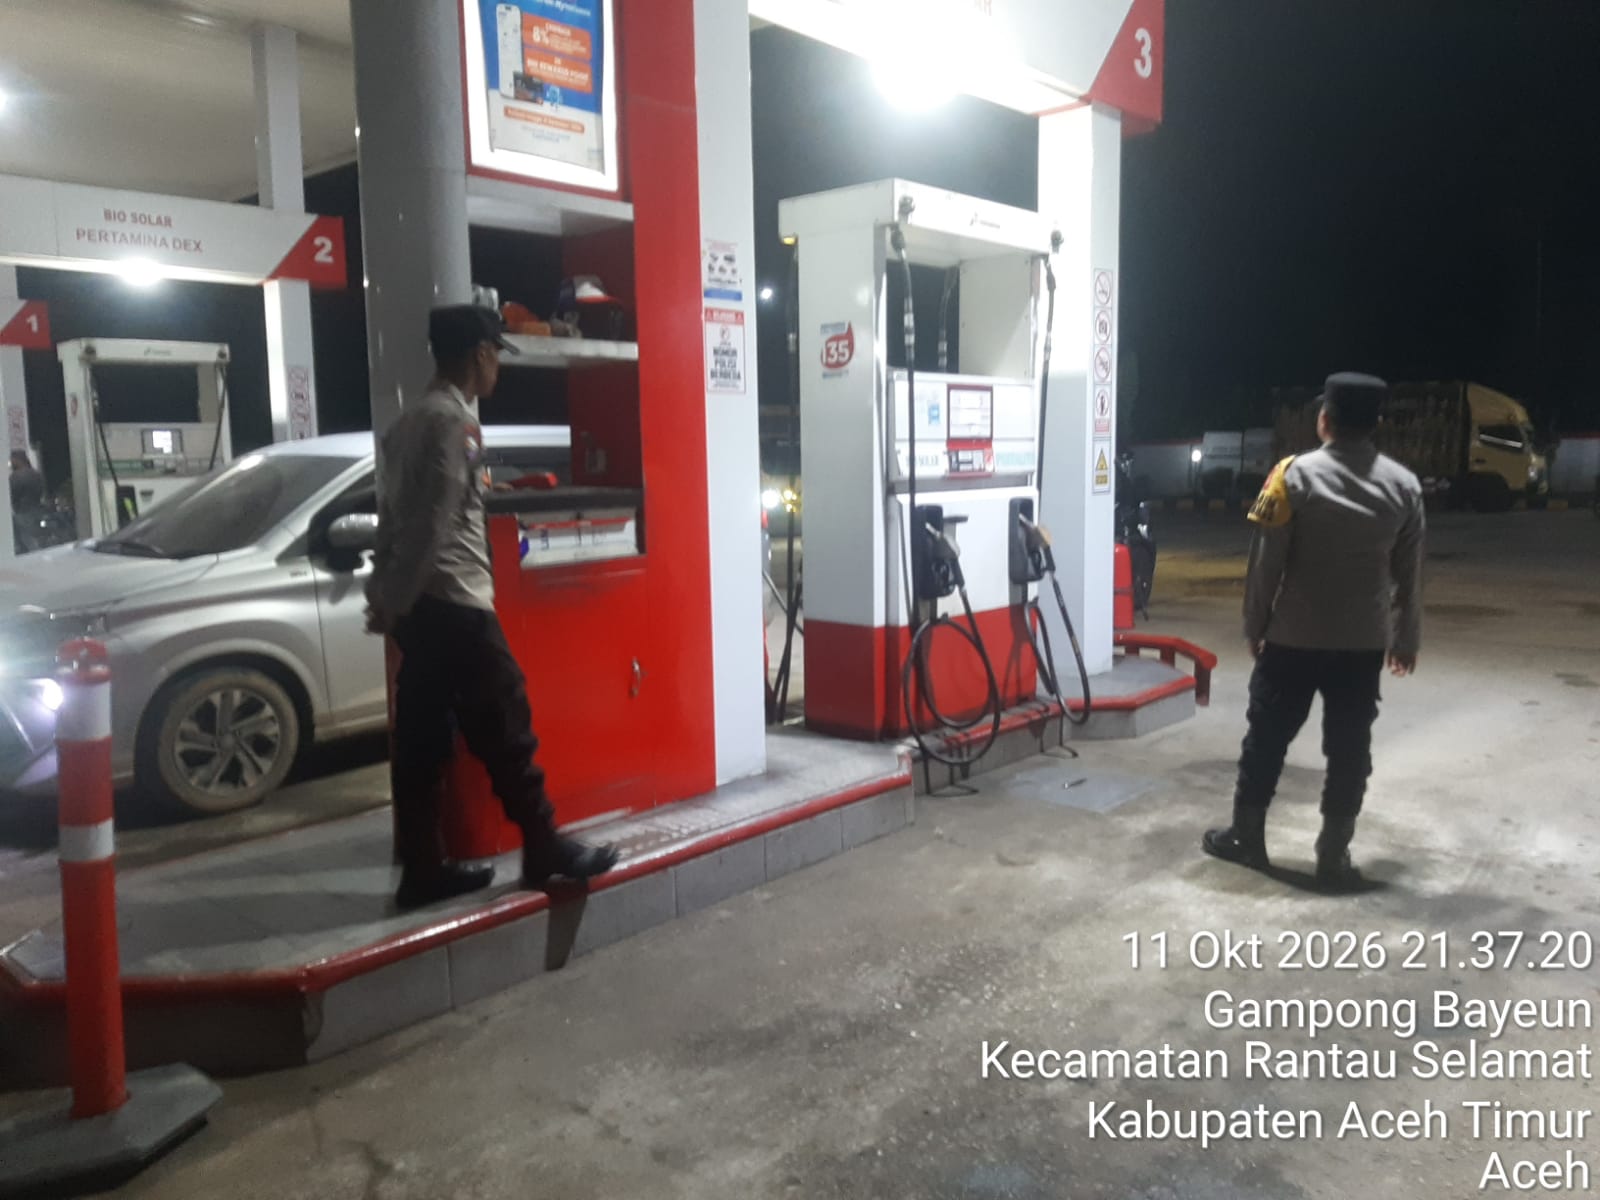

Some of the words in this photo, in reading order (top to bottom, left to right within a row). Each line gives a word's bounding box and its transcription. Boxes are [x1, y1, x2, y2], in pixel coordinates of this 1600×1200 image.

[1134, 27, 1152, 78] 3
[103, 208, 127, 224] BIO
[130, 211, 173, 228] SOLAR
[75, 228, 169, 249] PERTAMINA
[172, 238, 203, 252] DEX
[313, 236, 334, 263] 2
[26, 314, 38, 333] 1
